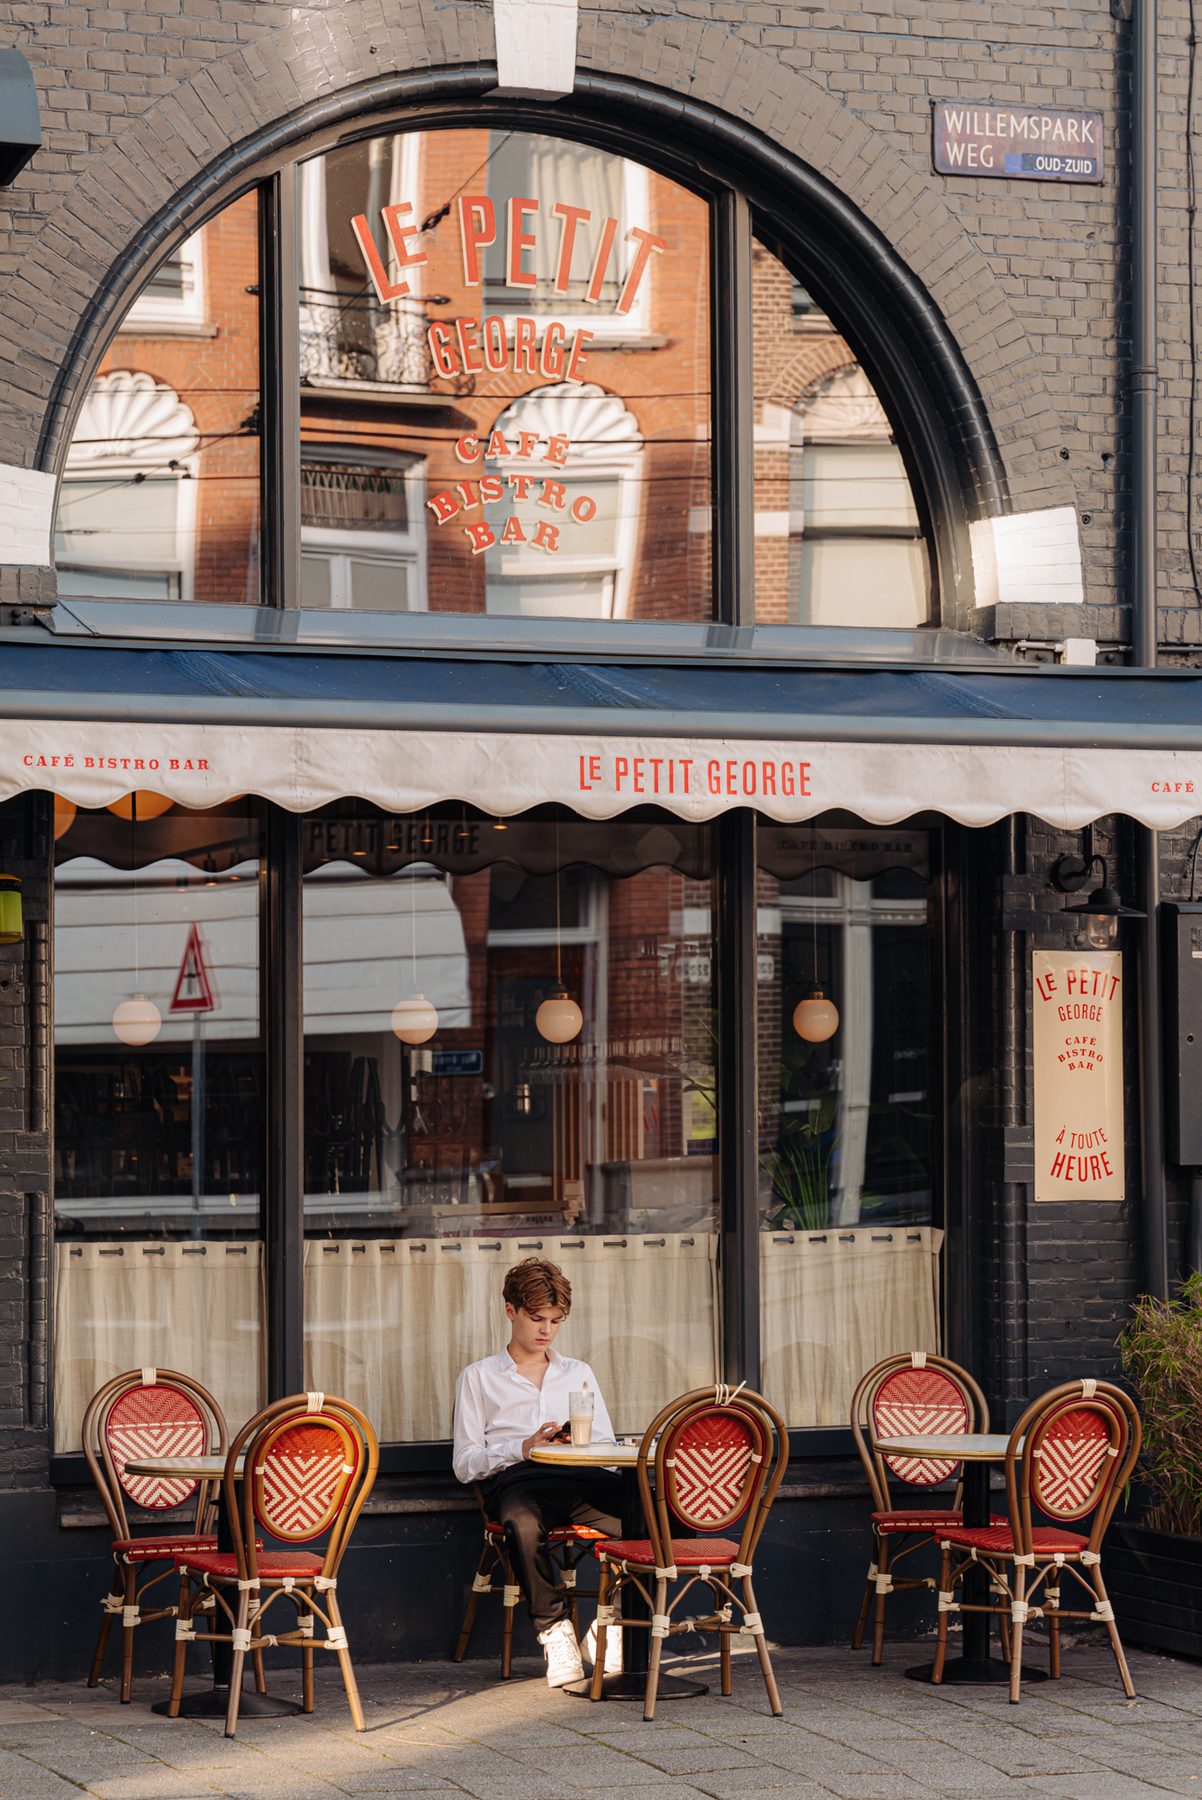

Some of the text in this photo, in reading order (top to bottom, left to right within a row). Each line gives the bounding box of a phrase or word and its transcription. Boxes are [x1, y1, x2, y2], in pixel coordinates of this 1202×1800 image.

[945, 110, 1095, 143] WILLEMSPARK
[946, 142, 994, 168] WEG
[1036, 156, 1093, 174] OUD-ZUID
[351, 195, 668, 316] LE PETIT
[427, 315, 595, 386] GEORGE
[455, 430, 570, 469] CAFÉ
[427, 474, 597, 525] BISTRO
[465, 516, 560, 555] BAR
[23, 753, 210, 771] CAFÉ BISTRO BAR
[579, 755, 812, 797] LE PETIT GEORGE
[1151, 780, 1194, 793] CAFÉ
[1036, 969, 1120, 1001] LE PETIT
[1058, 1004, 1103, 1022] GEORGE
[1065, 1035, 1096, 1046] CAFÉ
[1057, 1048, 1104, 1063] BISTRO
[1068, 1061, 1094, 1071] BAR
[1070, 1128, 1108, 1149] TOUTE
[1050, 1151, 1113, 1182] HEURE
